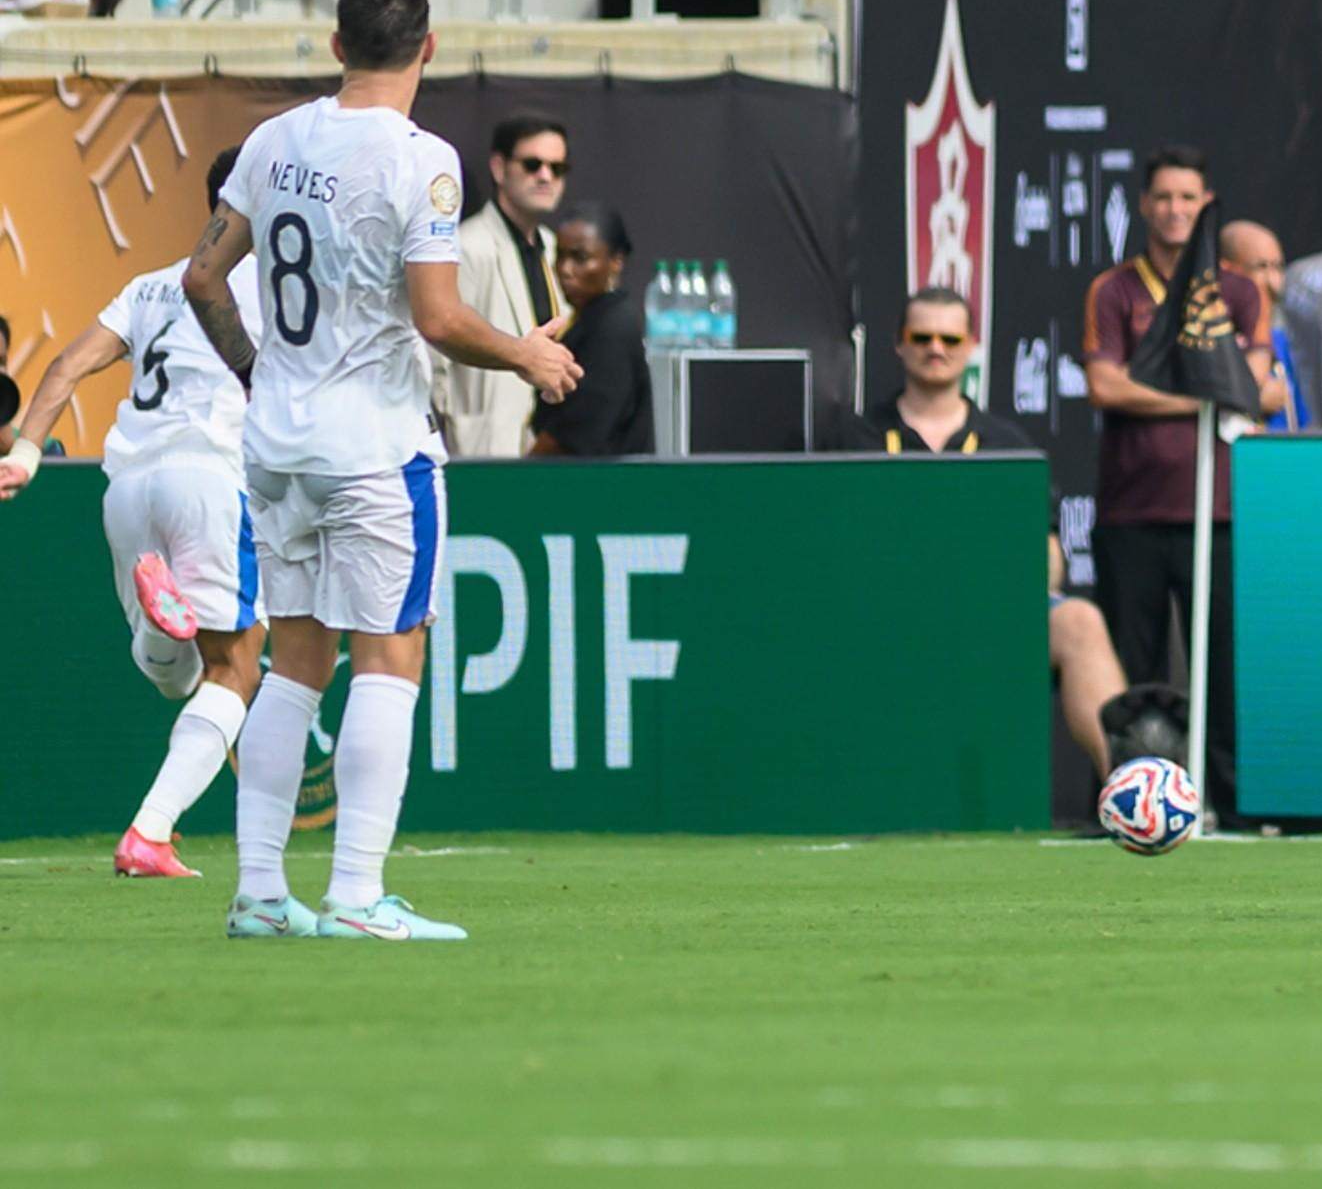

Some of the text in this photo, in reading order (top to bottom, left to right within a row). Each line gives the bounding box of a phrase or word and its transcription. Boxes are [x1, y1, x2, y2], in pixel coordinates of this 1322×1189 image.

[269, 160, 338, 203] NEVES
[270, 212, 320, 347] 8
[430, 534, 690, 771] PIF
